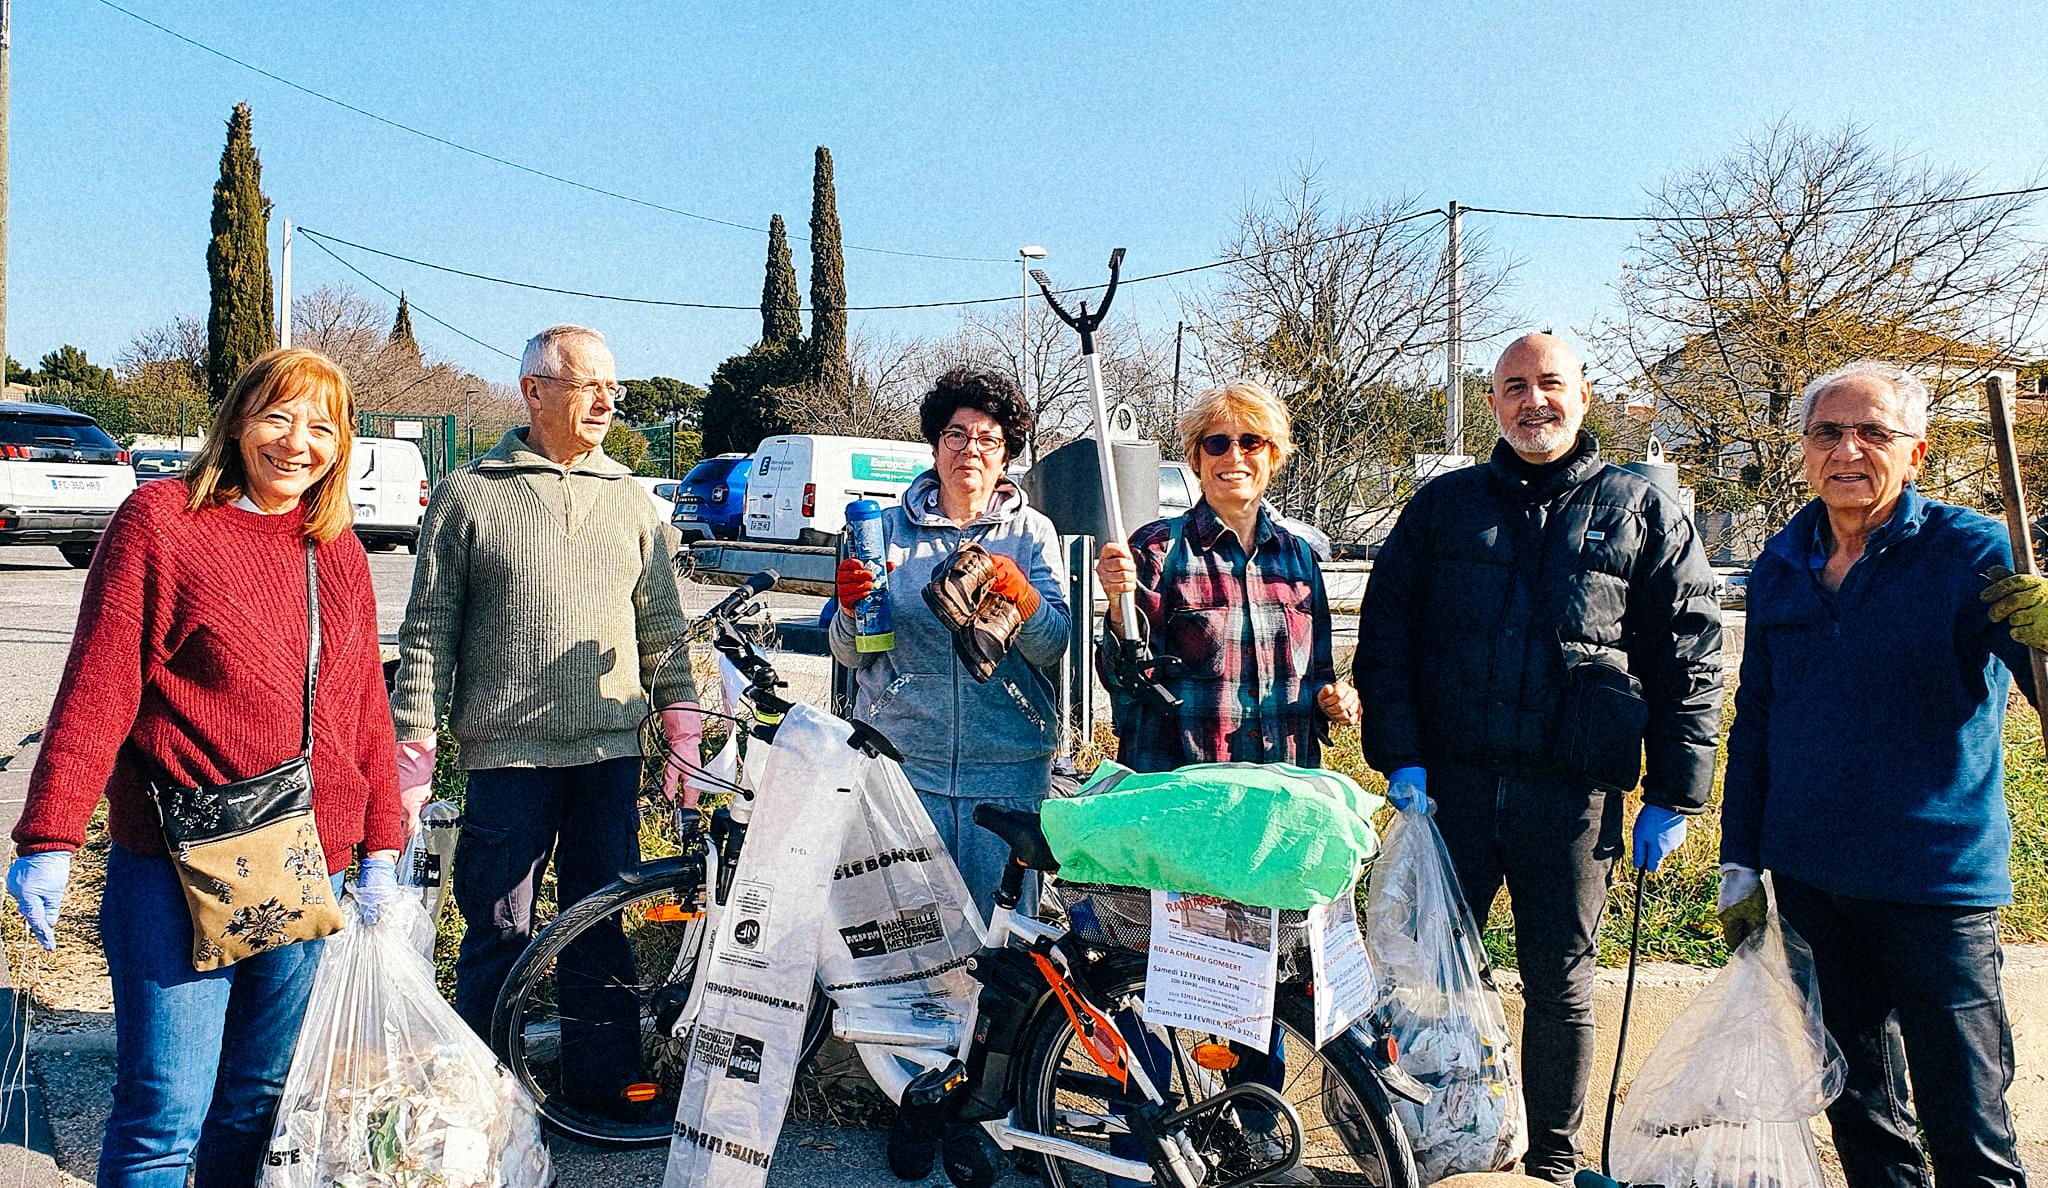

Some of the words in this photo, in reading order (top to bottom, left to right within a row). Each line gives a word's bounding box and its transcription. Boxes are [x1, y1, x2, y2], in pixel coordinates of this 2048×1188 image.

[736, 924, 758, 938] NF
[880, 912, 937, 933] MARSEILLE
[882, 921, 940, 941] PROVENCE
[1208, 958, 1242, 971] GOMBERT
[1153, 965, 1178, 976] Samedi
[1180, 970, 1188, 978] 12
[1189, 971, 1216, 985] FEVRIER
[1217, 980, 1240, 991] MATIN
[1147, 1006, 1182, 1018] Dimanche
[1184, 1011, 1192, 1020] 13
[729, 1054, 761, 1073] MPM
[708, 1135, 722, 1153] LE
[724, 1141, 770, 1170] FAITES
